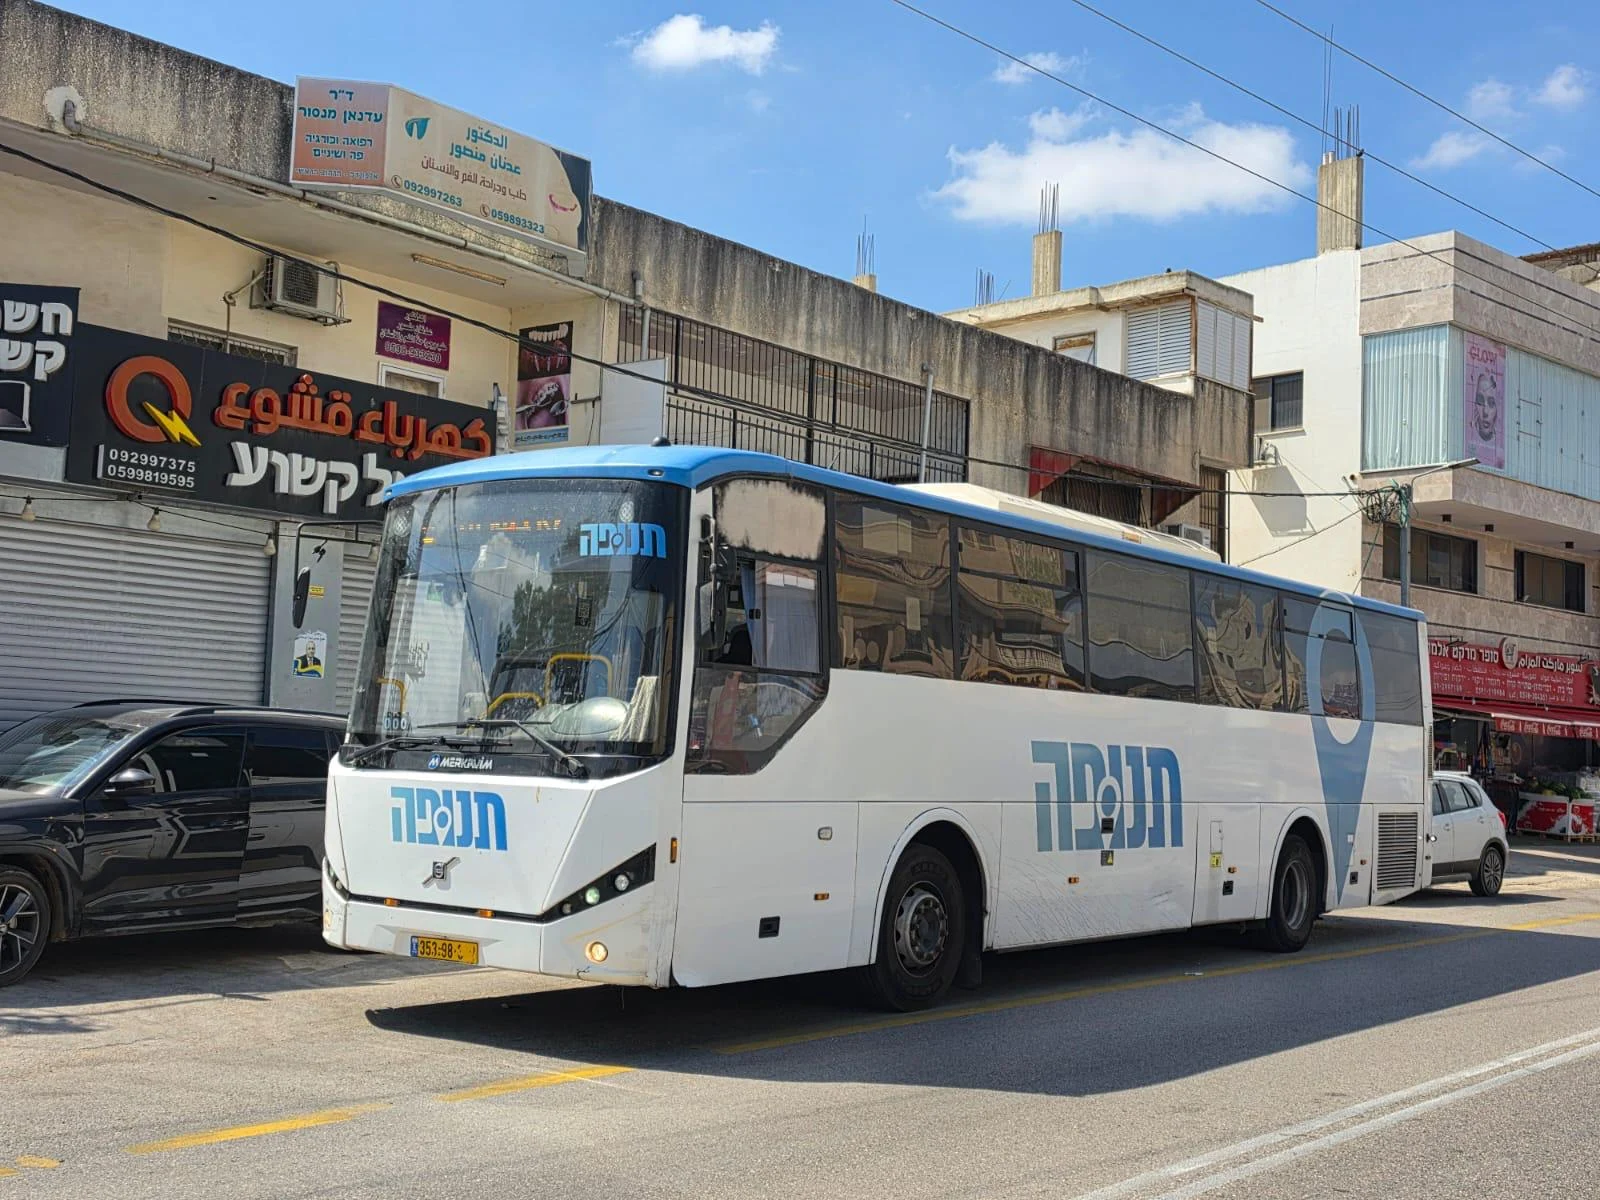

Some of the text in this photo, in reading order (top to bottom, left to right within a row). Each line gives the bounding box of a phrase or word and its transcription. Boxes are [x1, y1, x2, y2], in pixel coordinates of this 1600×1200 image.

[298, 106, 383, 124] עדנאן מנסור
[342, 137, 373, 147] רפואה
[466, 126, 508, 150] الدكتور
[350, 150, 364, 160] פה
[450, 142, 521, 175] عدنان منصور
[461, 172, 478, 185] الفم
[480, 176, 506, 196] وجراحة
[404, 180, 463, 208] 092997263
[508, 186, 527, 201] طب
[0, 300, 73, 336] חש
[214, 373, 492, 461] كهرباء قشوع
[108, 448, 196, 473] 092997375
[107, 464, 195, 488] 0599819595
[578, 522, 666, 559] תנופה
[1428, 640, 1449, 658] אלמ
[1452, 646, 1478, 662] מרקט
[1479, 649, 1499, 664] סופר
[1518, 652, 1540, 668] المرام
[1542, 658, 1564, 672] ماركت
[1566, 664, 1584, 674] سوبر
[1031, 740, 1184, 852] תנופה
[390, 786, 508, 851] תנופה
